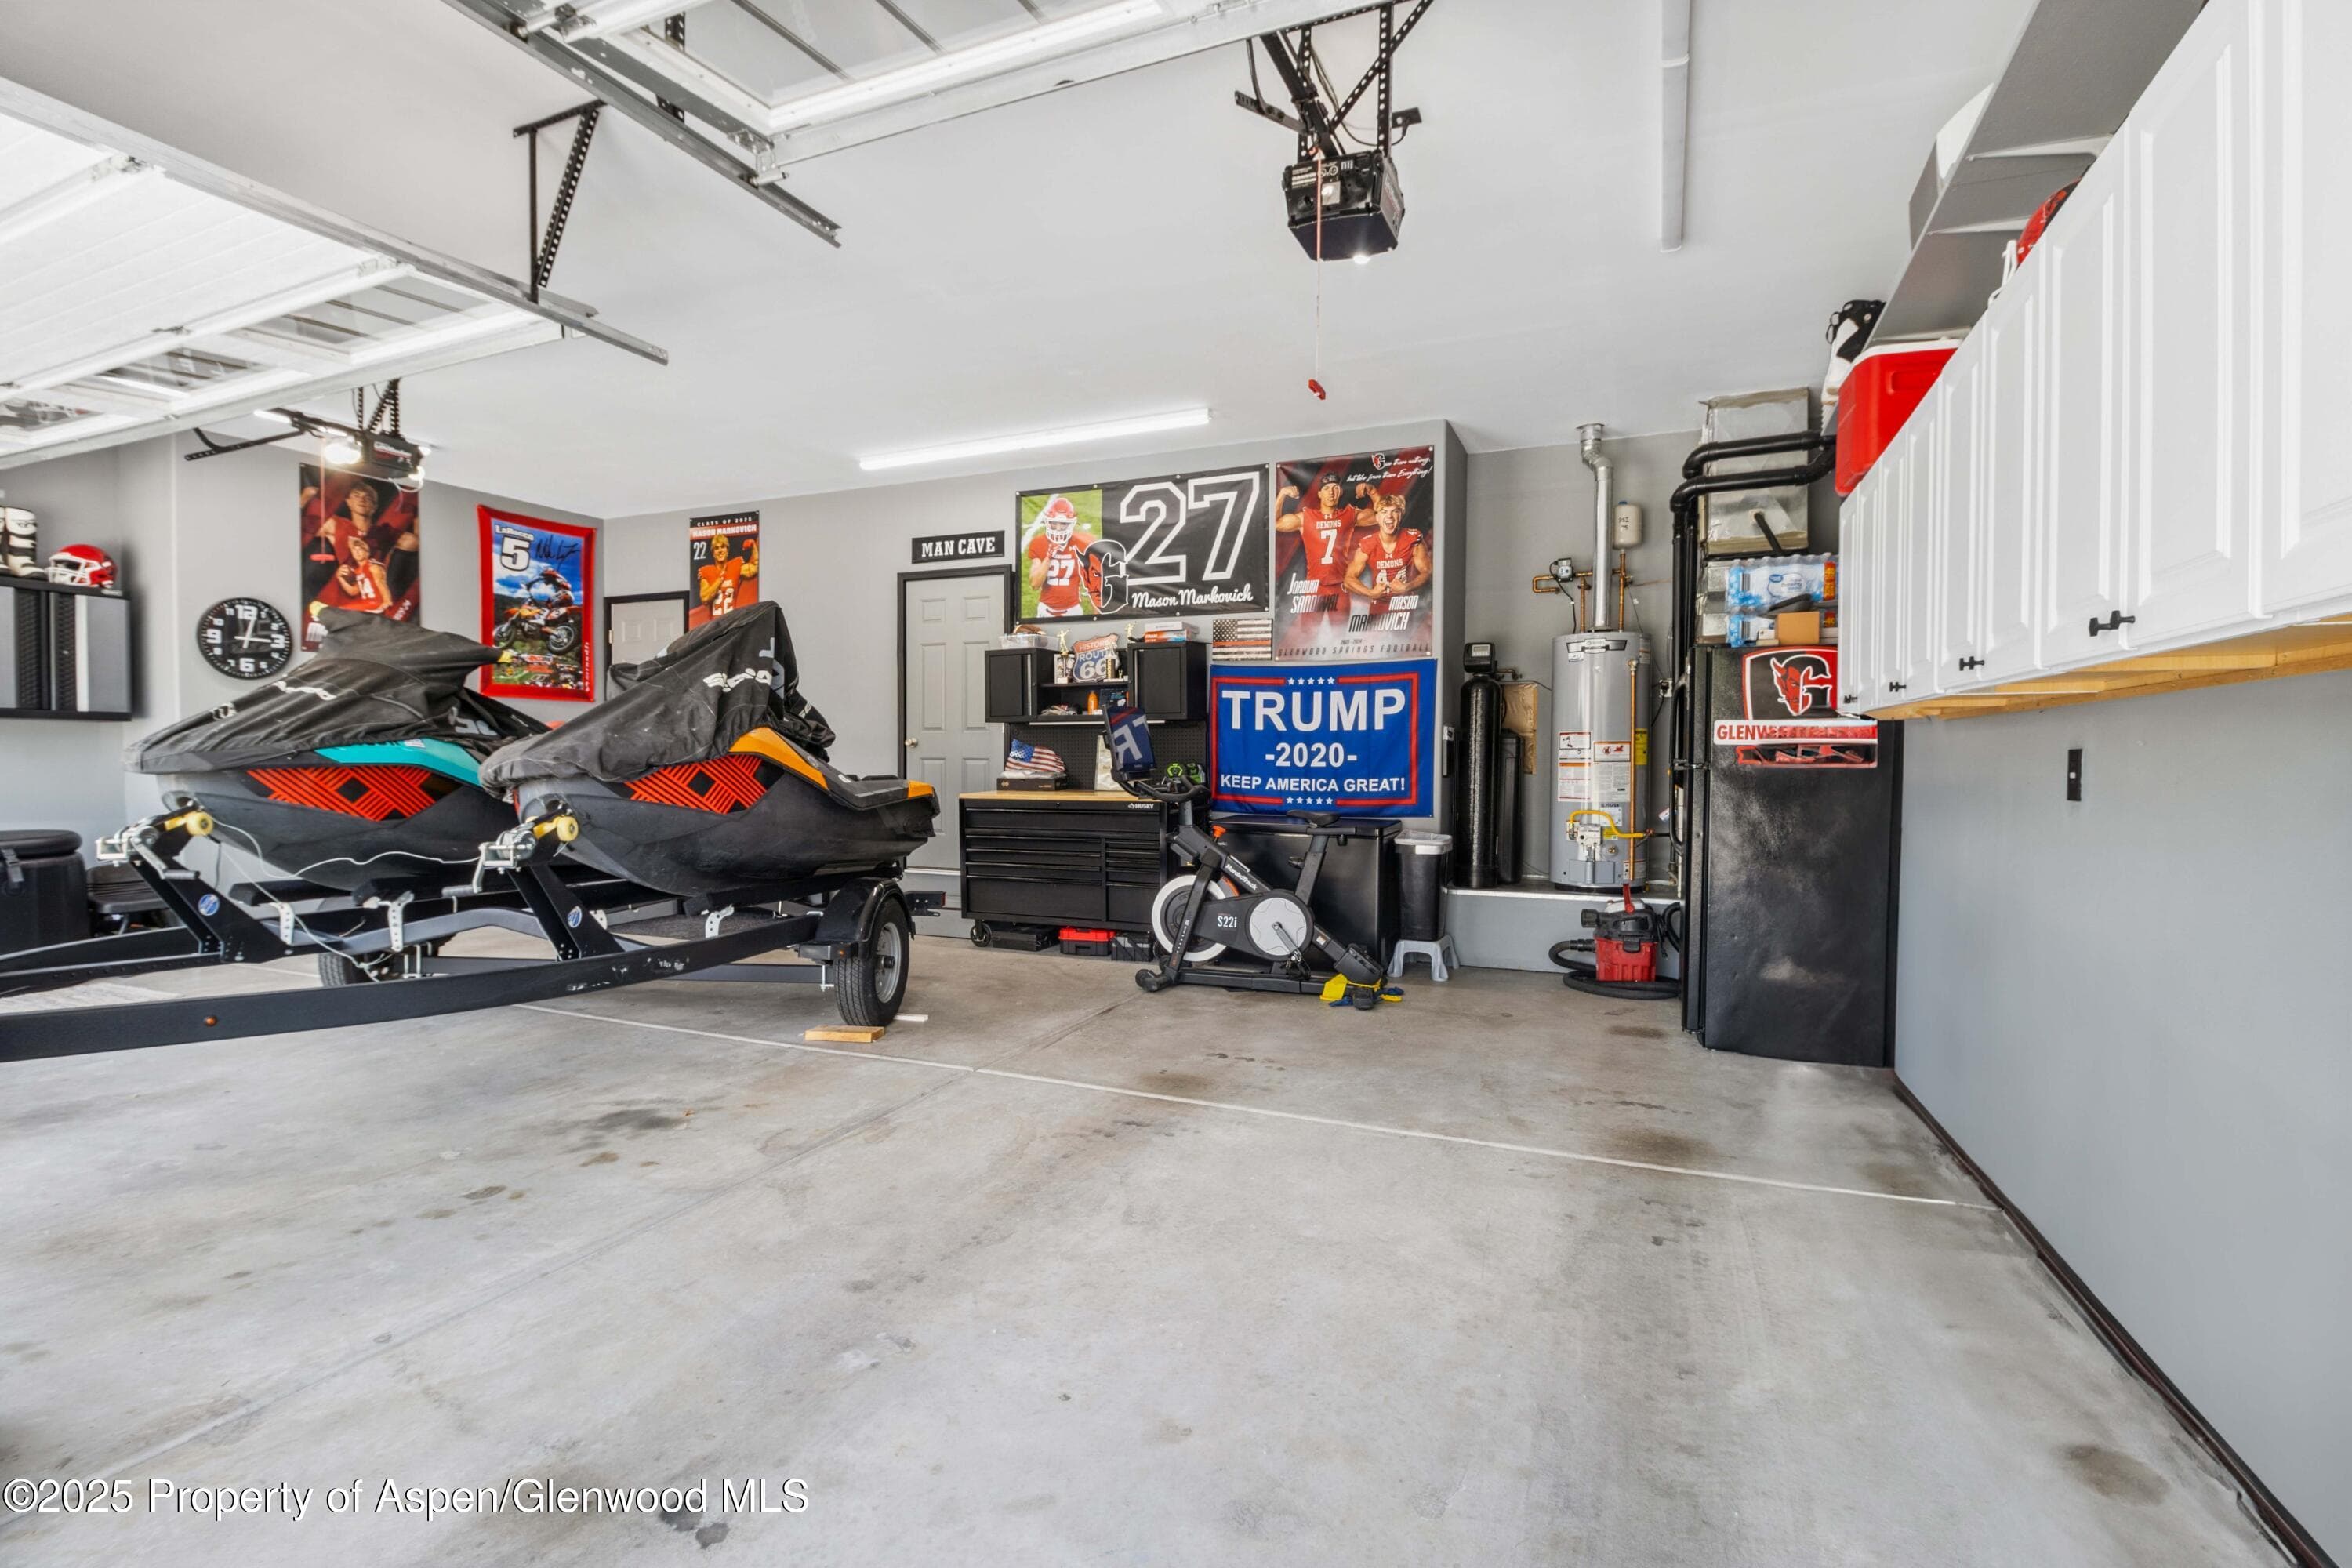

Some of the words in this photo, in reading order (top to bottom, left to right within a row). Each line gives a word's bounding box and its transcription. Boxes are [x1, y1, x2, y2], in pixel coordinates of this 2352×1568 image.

[717, 524, 757, 535] MARKOVICH
[1120, 471, 1260, 586] 27
[1316, 520, 1341, 529] DEMONS
[500, 535, 531, 572] 5
[693, 542, 706, 560] 22
[921, 540, 954, 557] MAN
[958, 537, 996, 555] CAVE
[1320, 529, 1338, 564] 7
[1376, 558, 1403, 569] DEMONS
[1047, 559, 1075, 586] 27
[1132, 592, 1178, 608] Mason
[1178, 583, 1254, 607] Markovich
[1388, 595, 1419, 611] MASON
[235, 604, 258, 620] 12
[206, 629, 222, 644] 9
[270, 633, 285, 648] 3
[1079, 650, 1107, 662] ROUT
[1278, 647, 1327, 657] GLENWOOD
[1333, 645, 1374, 654] SPRINGS
[1380, 643, 1429, 652] FOOTBALL
[239, 658, 255, 672] 6
[1080, 659, 1107, 679] 66
[1221, 688, 1406, 732] TRUMP
[1265, 742, 1358, 768] -2020-
[1221, 774, 1262, 789] KEEP
[1265, 777, 1339, 792] AMERICA
[1344, 777, 1406, 792] GREAT!
[1217, 916, 1237, 928] S22i
